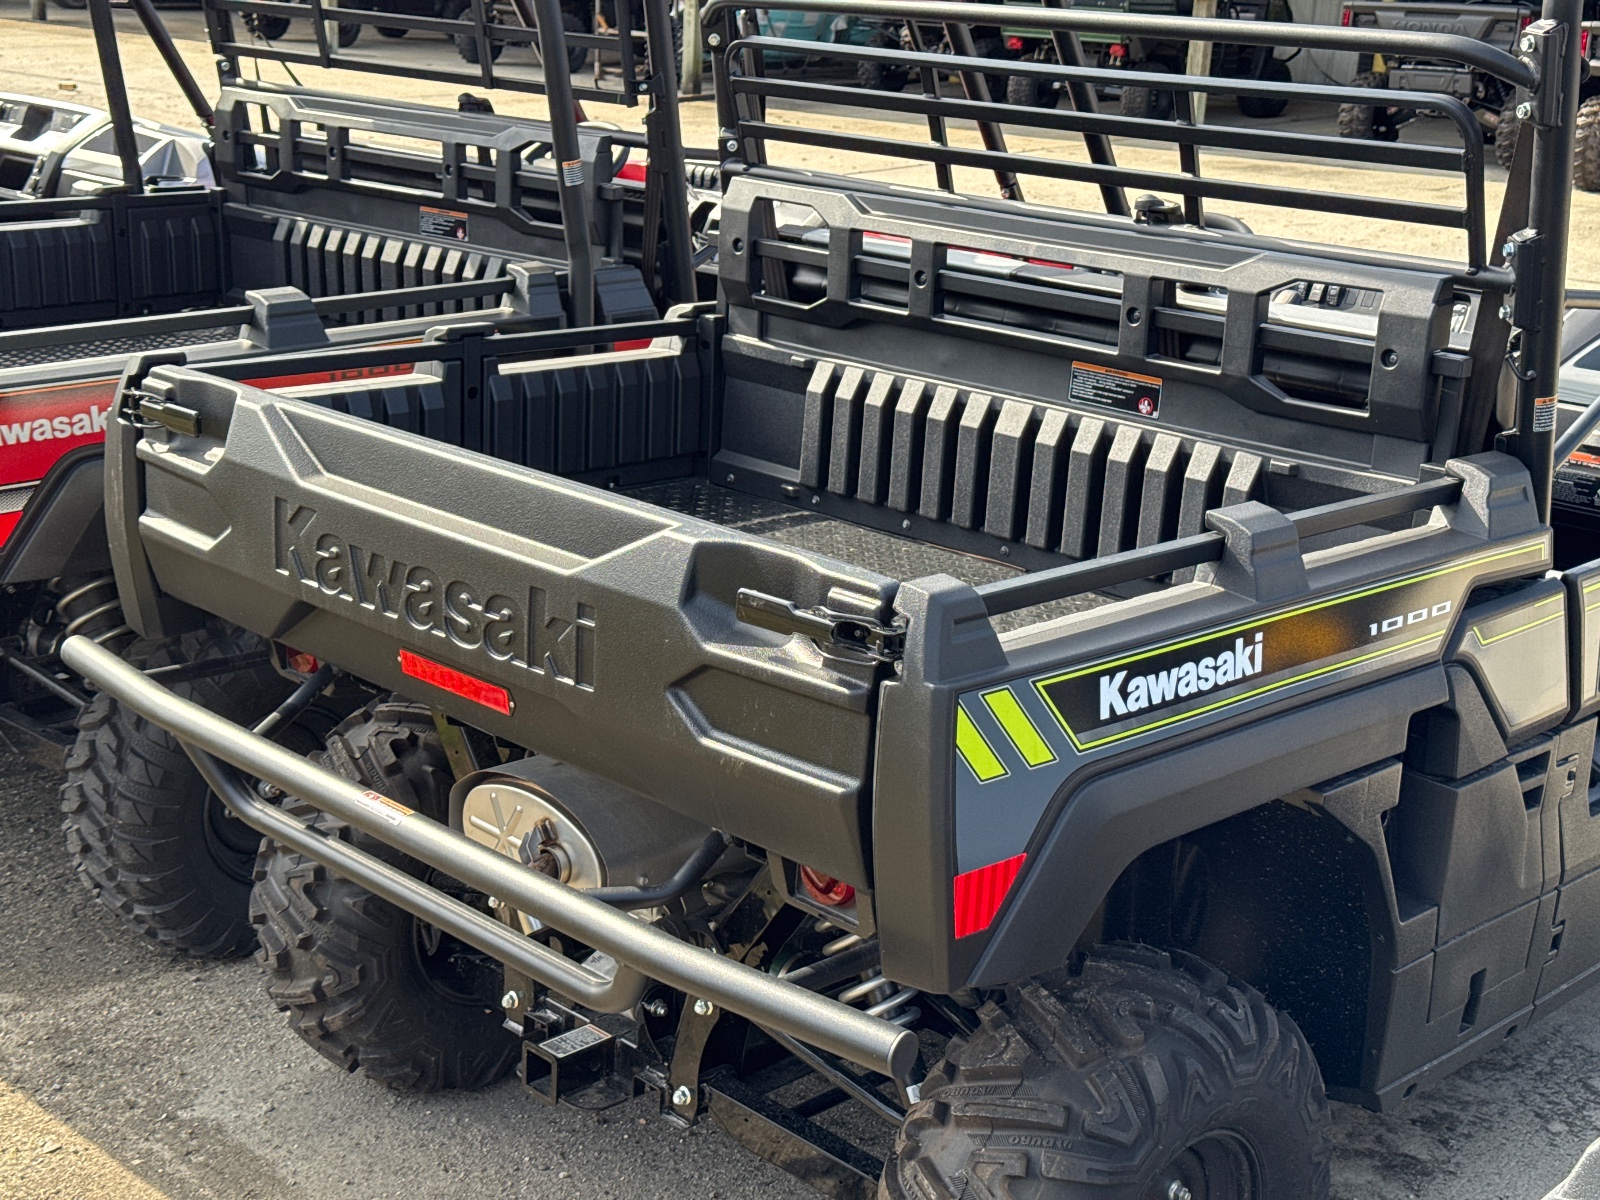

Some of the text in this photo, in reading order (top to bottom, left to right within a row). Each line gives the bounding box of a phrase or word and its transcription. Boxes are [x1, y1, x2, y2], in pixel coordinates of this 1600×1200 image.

[1391, 20, 1469, 36] HONDA
[0, 405, 108, 446] wasak
[274, 496, 596, 693] Kawasaki
[1369, 600, 1452, 636] 1000
[1100, 631, 1264, 721] Kawasaki
